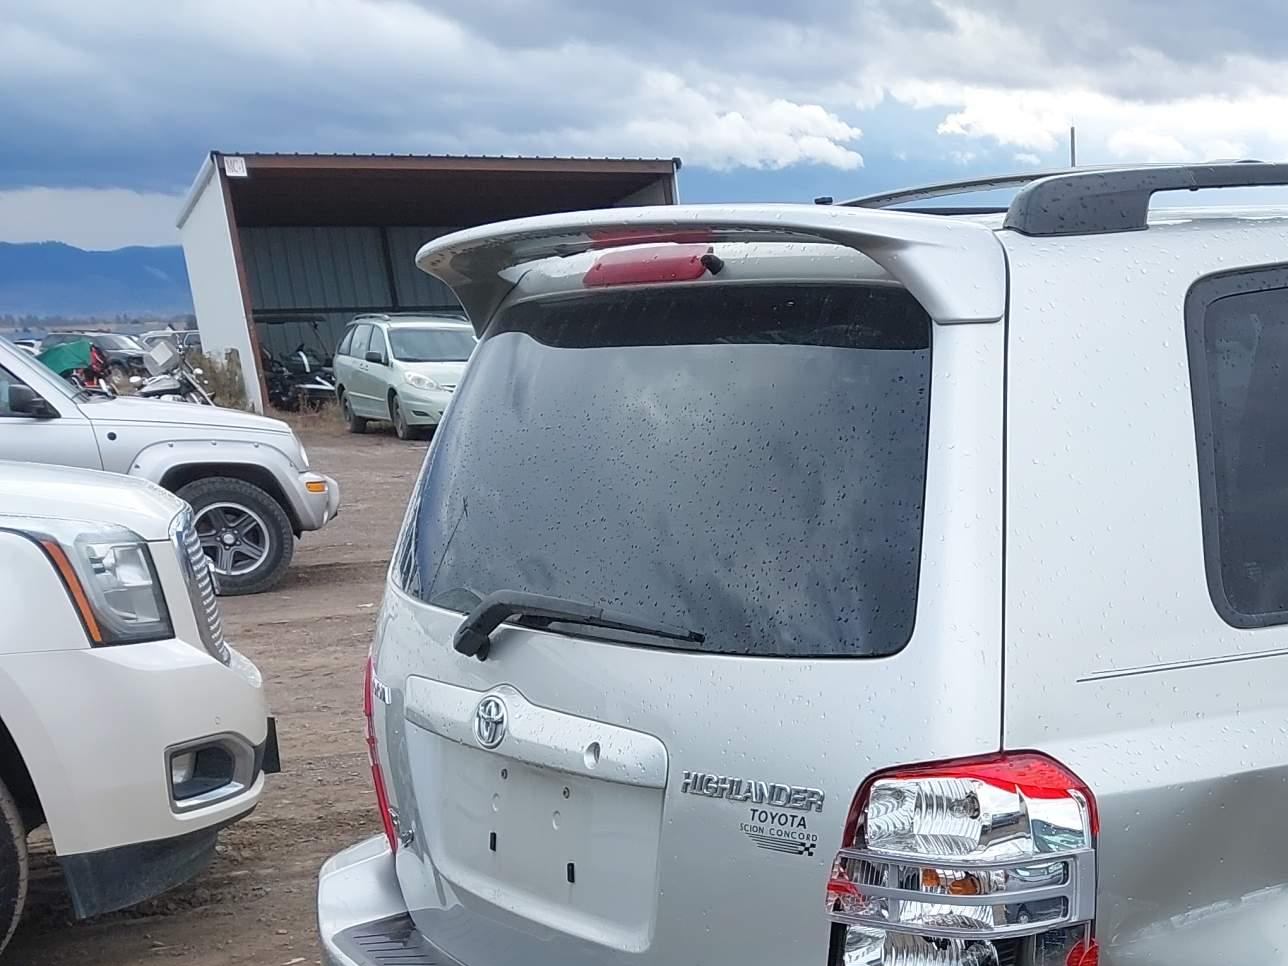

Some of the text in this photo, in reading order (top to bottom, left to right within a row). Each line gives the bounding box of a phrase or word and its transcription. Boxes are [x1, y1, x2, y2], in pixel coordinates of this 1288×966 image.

[681, 770, 825, 812] HIGHLANDER
[750, 808, 807, 829] TOYOTA
[739, 823, 818, 842] SCION CONCORD
